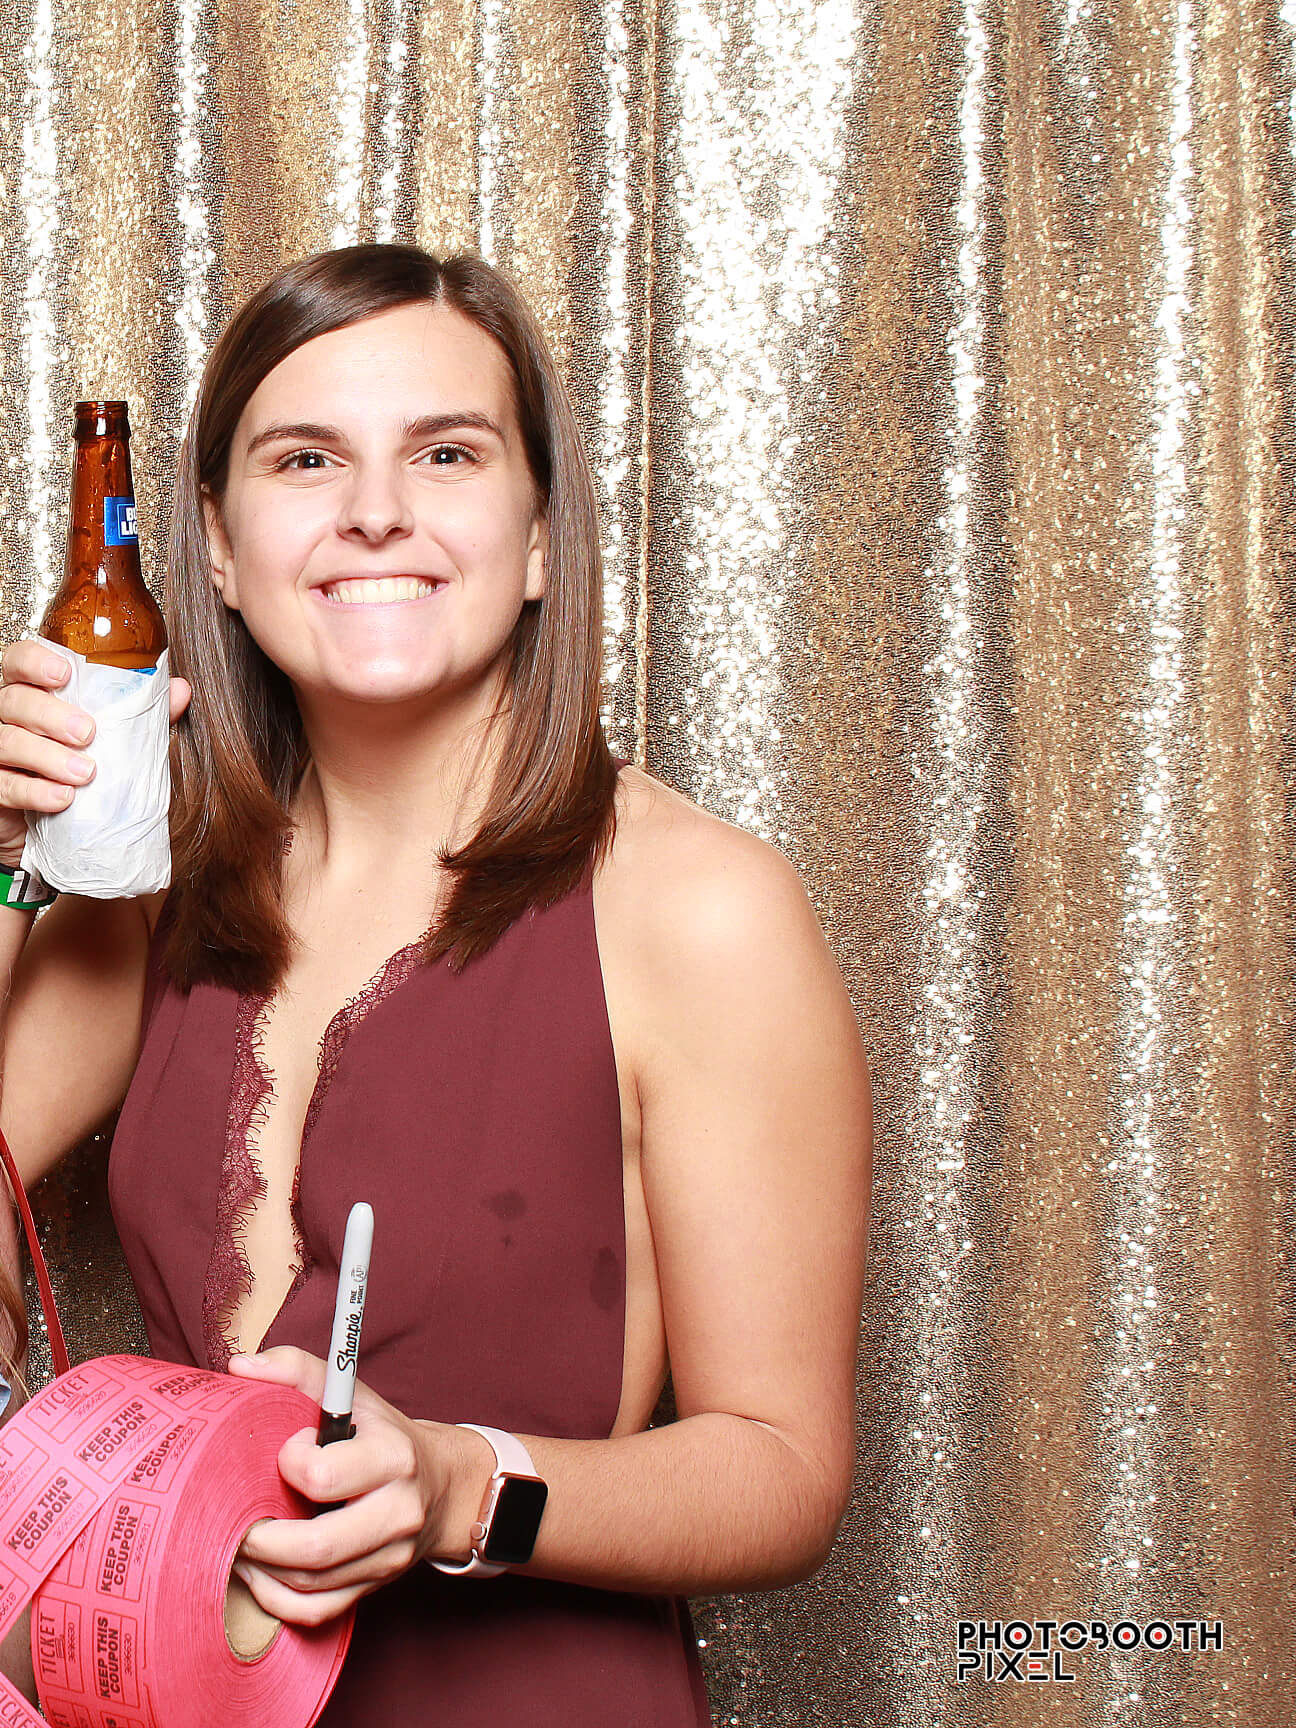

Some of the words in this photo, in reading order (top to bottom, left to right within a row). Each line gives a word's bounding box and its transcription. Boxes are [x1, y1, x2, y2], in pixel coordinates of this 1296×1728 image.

[357, 1285, 365, 1304] POINT
[337, 1311, 362, 1377] Sharpie
[36, 1372, 89, 1416] TICKET
[78, 1426, 113, 1460] KEEP
[112, 1399, 143, 1426] THIS
[94, 1412, 147, 1462] COUPON
[130, 1447, 154, 1481] KEE
[7, 1509, 41, 1549] KEEP
[37, 1475, 68, 1509] THIS
[21, 1490, 72, 1550] COUPON
[100, 1547, 117, 1590] KEEP
[110, 1504, 129, 1540] THIS
[113, 1516, 138, 1584] COUPON
[40, 1611, 56, 1673] TICKET
[98, 1616, 107, 1652] THIS
[108, 1628, 120, 1693] COUPON
[97, 1657, 109, 1697] KEEP
